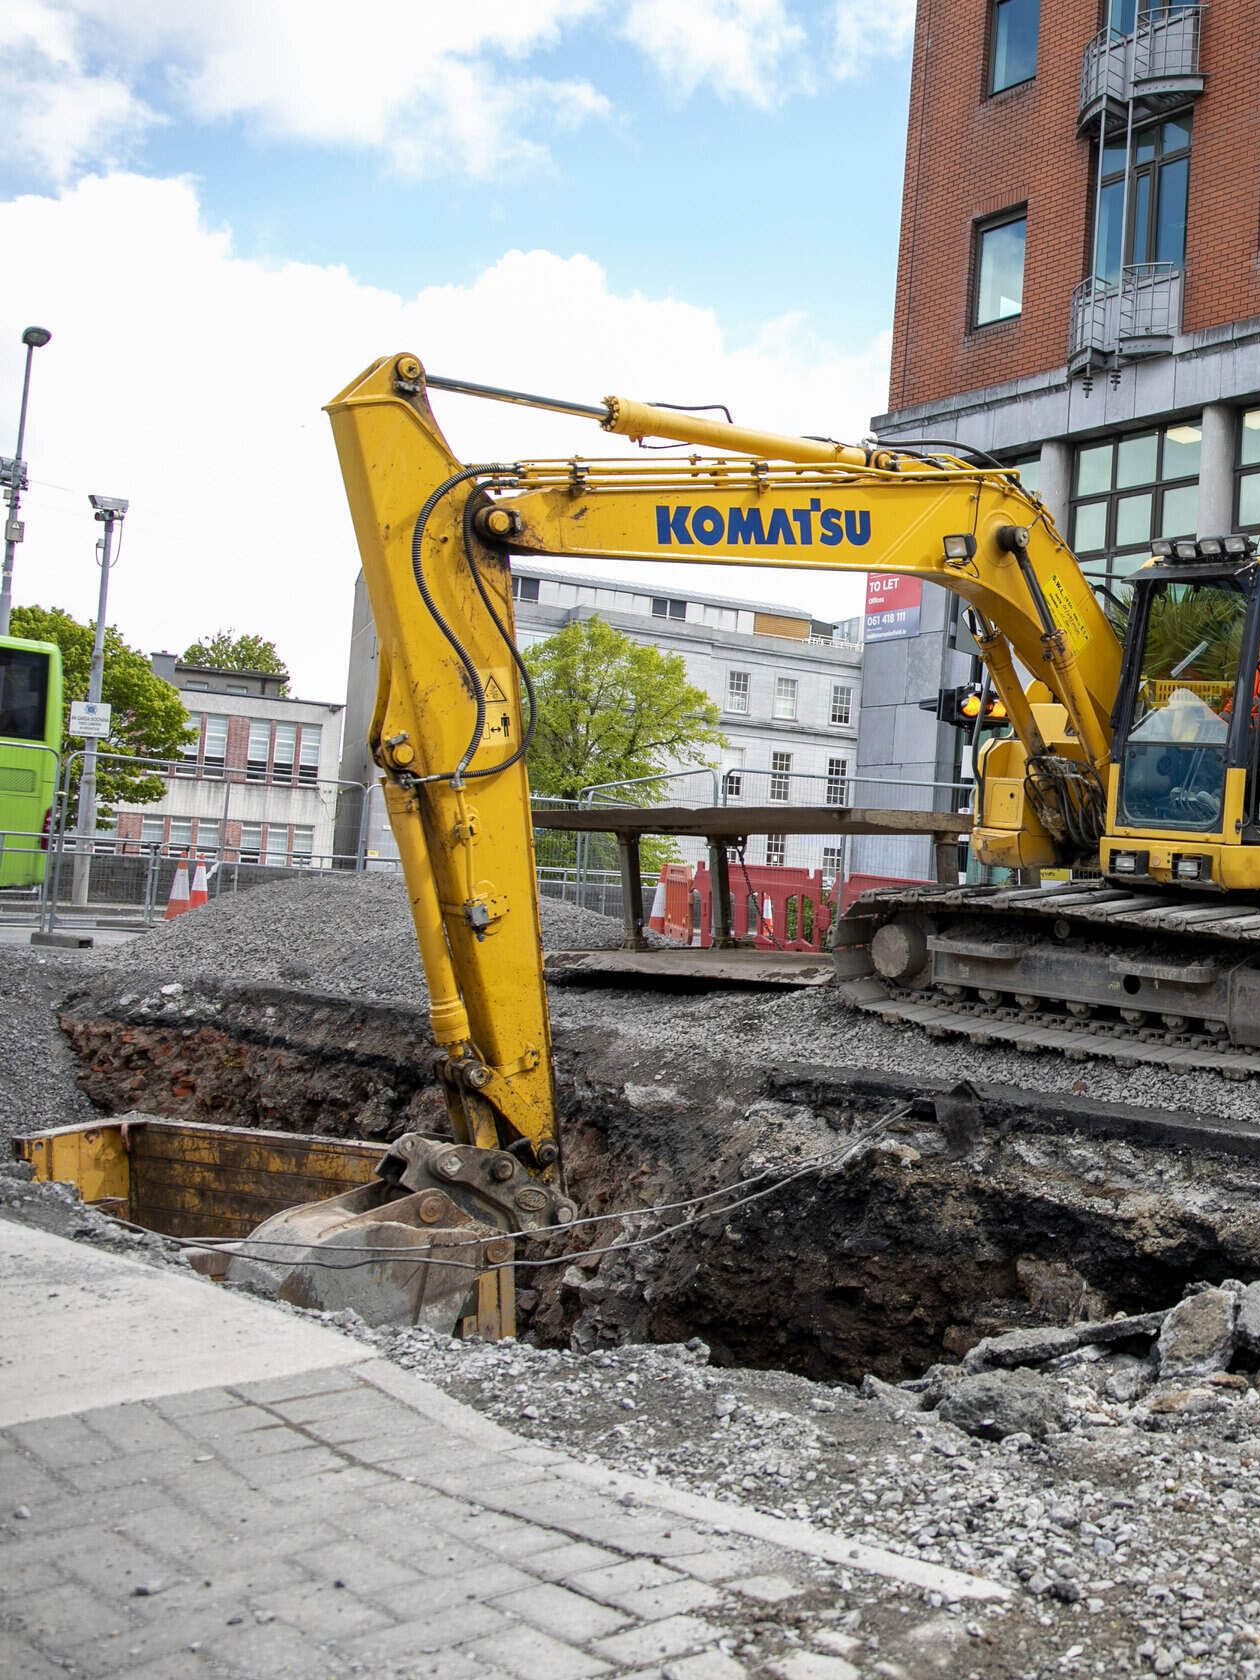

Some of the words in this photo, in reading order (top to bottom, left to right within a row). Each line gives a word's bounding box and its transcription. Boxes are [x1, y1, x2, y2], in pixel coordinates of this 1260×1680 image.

[655, 498, 871, 546] KOMATSU
[869, 581, 881, 593] TO
[882, 577, 900, 591] LET
[882, 613, 895, 625] 418
[896, 611, 906, 623] 111
